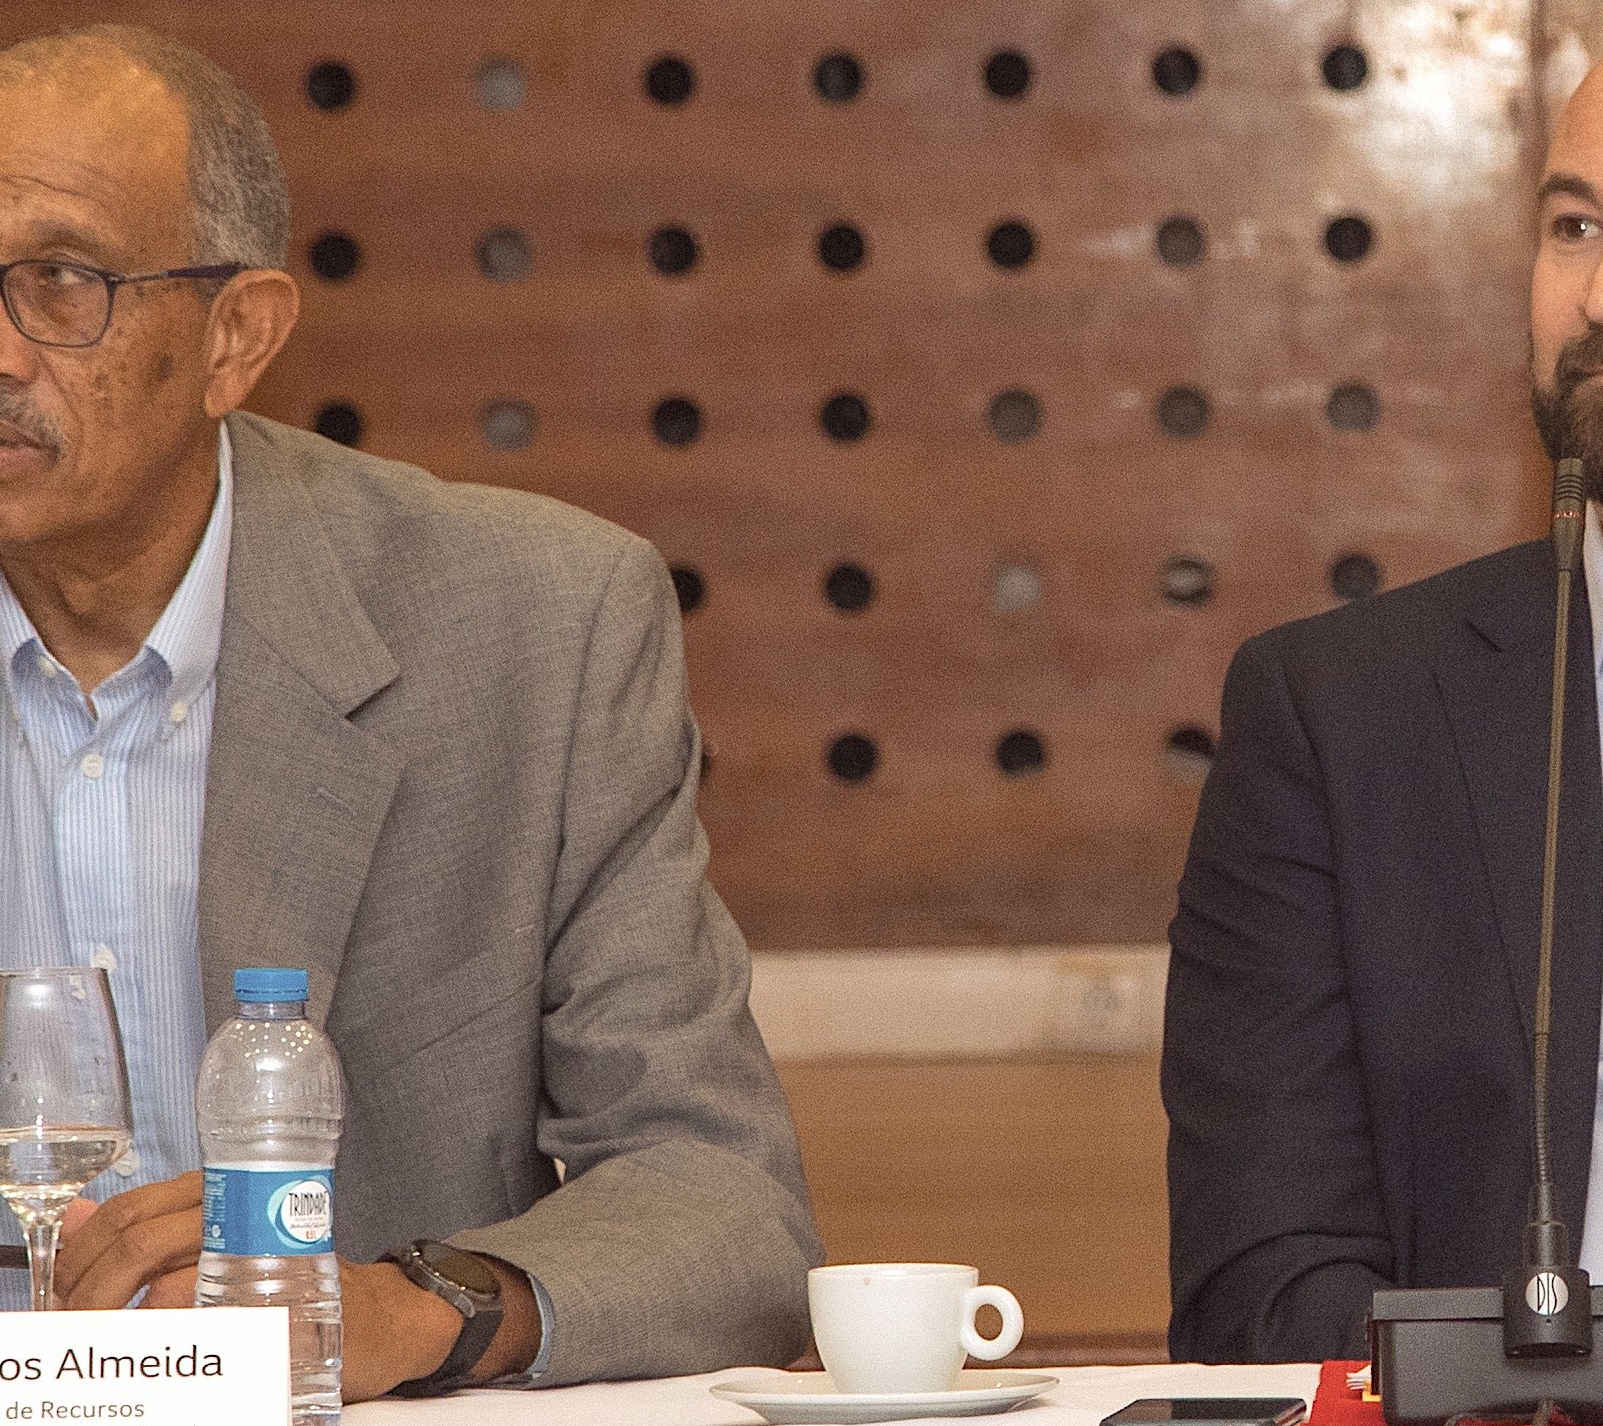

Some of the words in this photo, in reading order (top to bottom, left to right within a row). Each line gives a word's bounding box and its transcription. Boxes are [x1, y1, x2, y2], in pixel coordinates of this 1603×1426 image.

[1536, 1273, 1558, 1315] DIS
[54, 1343, 224, 1380] Almeida
[5, 1400, 34, 1420] de
[40, 1400, 145, 1420] Recursos
